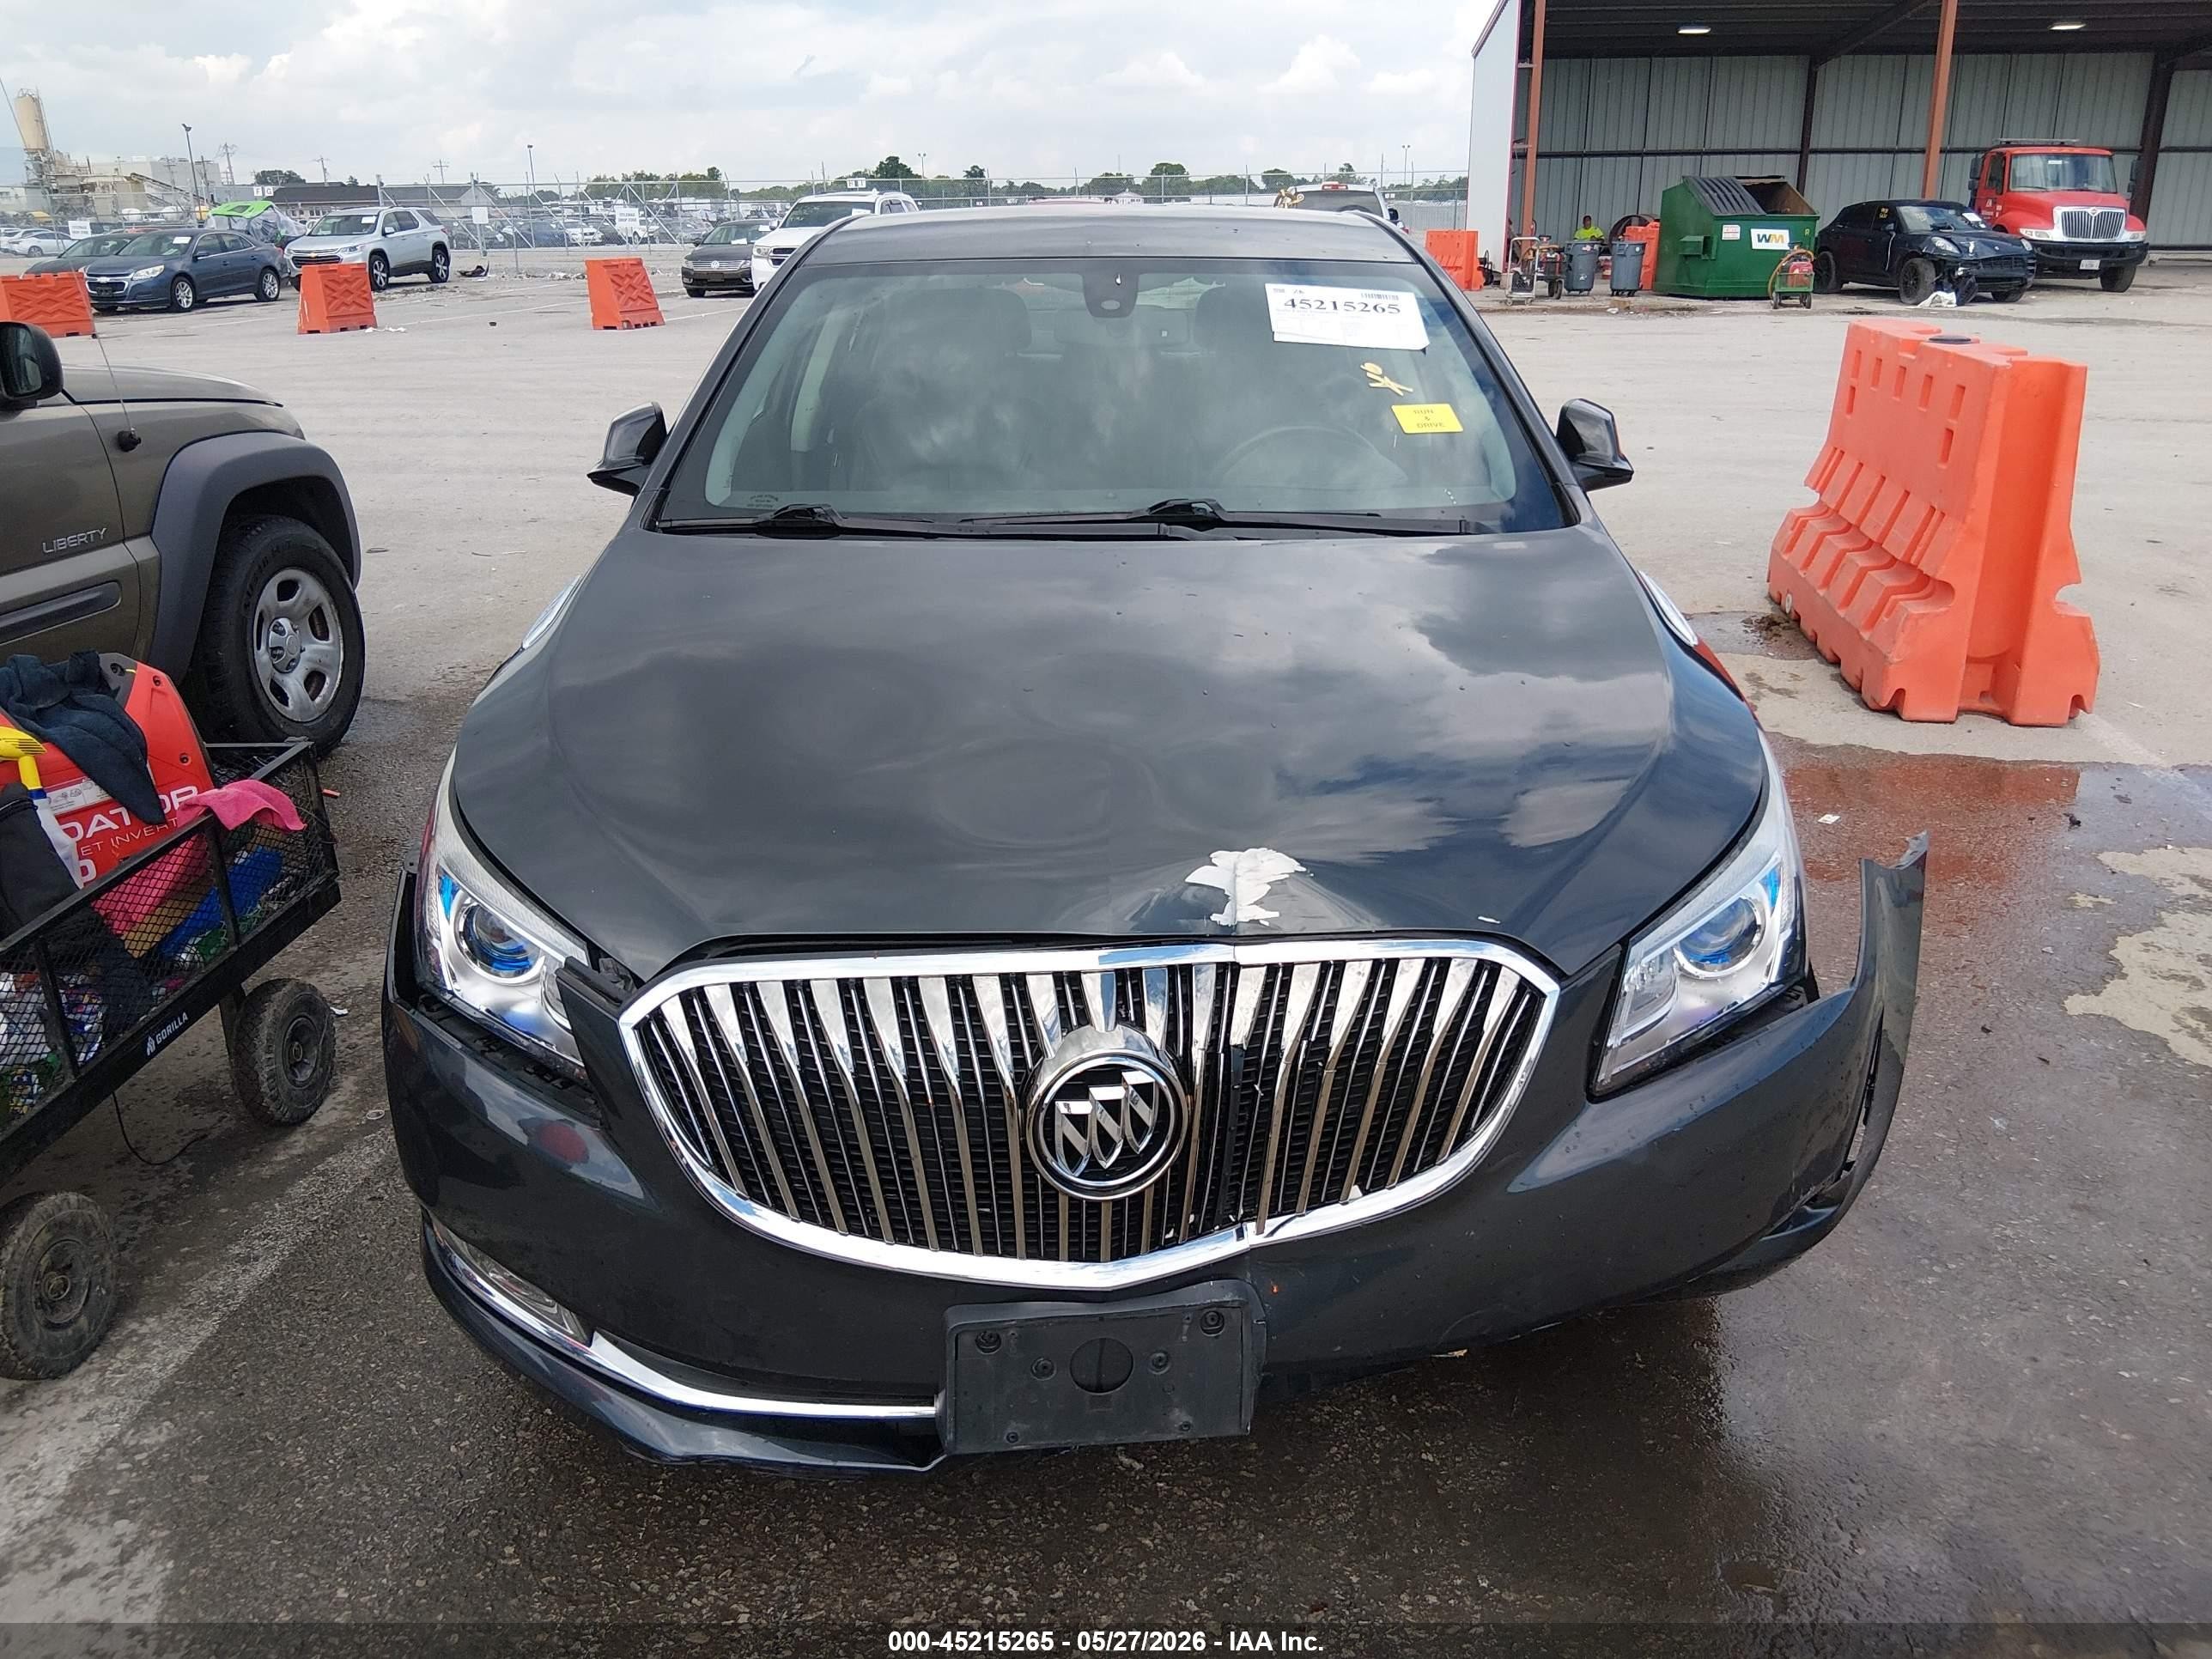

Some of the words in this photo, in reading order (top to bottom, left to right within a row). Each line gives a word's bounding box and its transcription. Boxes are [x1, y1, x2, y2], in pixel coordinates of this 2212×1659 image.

[1756, 234, 1784, 244] WM
[1284, 298, 1401, 315] 45215265
[43, 527, 107, 554] LIBERTY
[155, 1012, 189, 1045] GORILLA
